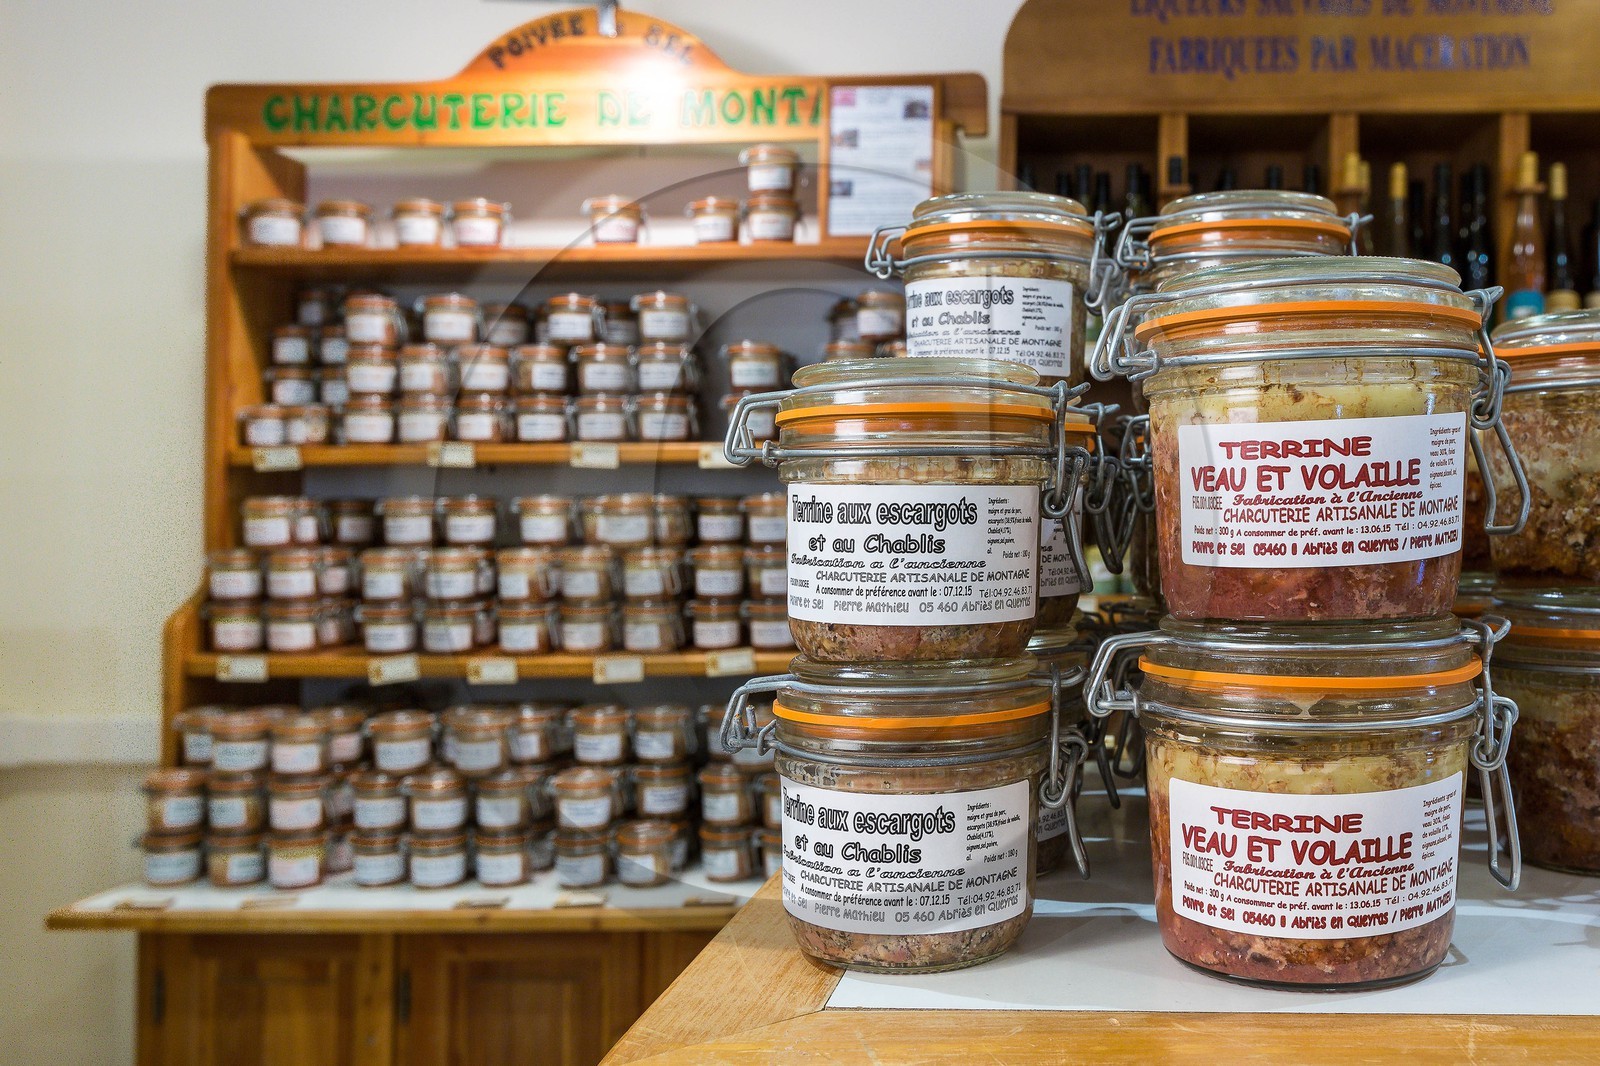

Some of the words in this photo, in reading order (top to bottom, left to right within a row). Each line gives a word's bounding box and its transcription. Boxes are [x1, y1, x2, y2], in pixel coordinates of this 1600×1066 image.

[1310, 35, 1357, 72] PAR
[262, 92, 567, 131] CHARCUTERIE
[597, 91, 651, 127] DE
[946, 285, 1015, 310] escargots
[938, 311, 991, 326] Chablis
[954, 337, 1007, 346] ARTISANALE
[1009, 337, 1020, 346] DE
[1021, 338, 1063, 348] MONTAGNE
[1218, 436, 1373, 461] TERRINE
[1190, 465, 1247, 492] VEAU
[1256, 465, 1292, 492] ET
[1300, 458, 1422, 491] VOLAILLE
[1232, 493, 1327, 506] Fabrication
[1330, 492, 1343, 504] à
[1347, 489, 1424, 504] l'Ancienne
[792, 494, 833, 523] Terrine
[837, 502, 871, 524] aux
[876, 496, 978, 532] escargots
[1223, 506, 1311, 524] CHARCUTERIE
[1315, 503, 1398, 522] ARTISANALE
[1402, 501, 1415, 518] DE
[1418, 495, 1459, 516] MONTAGNE
[1218, 526, 1229, 536] 300
[1236, 528, 1242, 537] A
[1243, 529, 1286, 538] consommer
[1287, 528, 1299, 537] de
[1300, 526, 1321, 539] préf.
[1322, 528, 1345, 536] avant
[1346, 526, 1354, 535] le
[1360, 524, 1391, 534] 13.06.15
[808, 534, 826, 552] et
[832, 538, 855, 553] au
[864, 533, 946, 554] Chablis
[1253, 542, 1287, 557] 05460
[1302, 541, 1338, 556] Abriès
[888, 557, 986, 570] l'ancienne
[816, 570, 887, 583] CHARCUTERIE
[890, 572, 968, 583] ARTISANALE
[970, 571, 984, 582] DE
[987, 569, 1030, 582] MONTAGNE
[816, 585, 821, 594] A
[821, 587, 854, 596] consommer
[855, 586, 864, 596] de
[865, 586, 907, 599] préférence
[908, 586, 929, 597] avant
[930, 586, 937, 597] le
[943, 586, 973, 597] 07.12.15
[918, 601, 934, 613] 05
[937, 601, 959, 612] 460
[783, 786, 815, 825] Terrine
[818, 807, 849, 832] aux
[853, 805, 956, 841] escargots
[1209, 805, 1364, 834] TERRINE
[794, 834, 809, 852] et
[814, 842, 834, 858] au
[841, 841, 922, 864] Chablis
[1181, 823, 1238, 858] VEAU
[1247, 835, 1282, 862] ET
[1291, 832, 1413, 866] VOLAILLE
[800, 869, 864, 892] CHARCUTERIE
[866, 881, 945, 893] ARTISANALE
[948, 879, 963, 891] DE
[965, 866, 1018, 888] MONTAGNE
[865, 867, 966, 879] l'ancienne
[1213, 872, 1300, 897] CHARCUTERIE
[1305, 877, 1388, 897] ARTISANALE
[1392, 875, 1406, 892] DE
[1409, 857, 1453, 888] MONTAGNE
[1223, 860, 1317, 880] Fabrication
[1320, 869, 1333, 880] à
[1336, 862, 1415, 879] l'Ancienne
[834, 892, 842, 903] de
[843, 893, 882, 906] préférence
[883, 896, 904, 907] avant
[906, 896, 913, 906] le
[919, 894, 951, 906] 07.12.15
[1209, 888, 1220, 899] 300
[1226, 894, 1232, 902] A
[1233, 896, 1276, 908] consommer
[1277, 900, 1288, 909] de
[1289, 901, 1310, 912] préf.
[1311, 902, 1334, 911] avant
[1335, 900, 1343, 910] le
[1349, 899, 1381, 910] 13.06.15
[894, 911, 910, 923] 05
[913, 911, 936, 922] 460
[1242, 910, 1277, 927] 05460
[1291, 915, 1328, 930] Abriès
